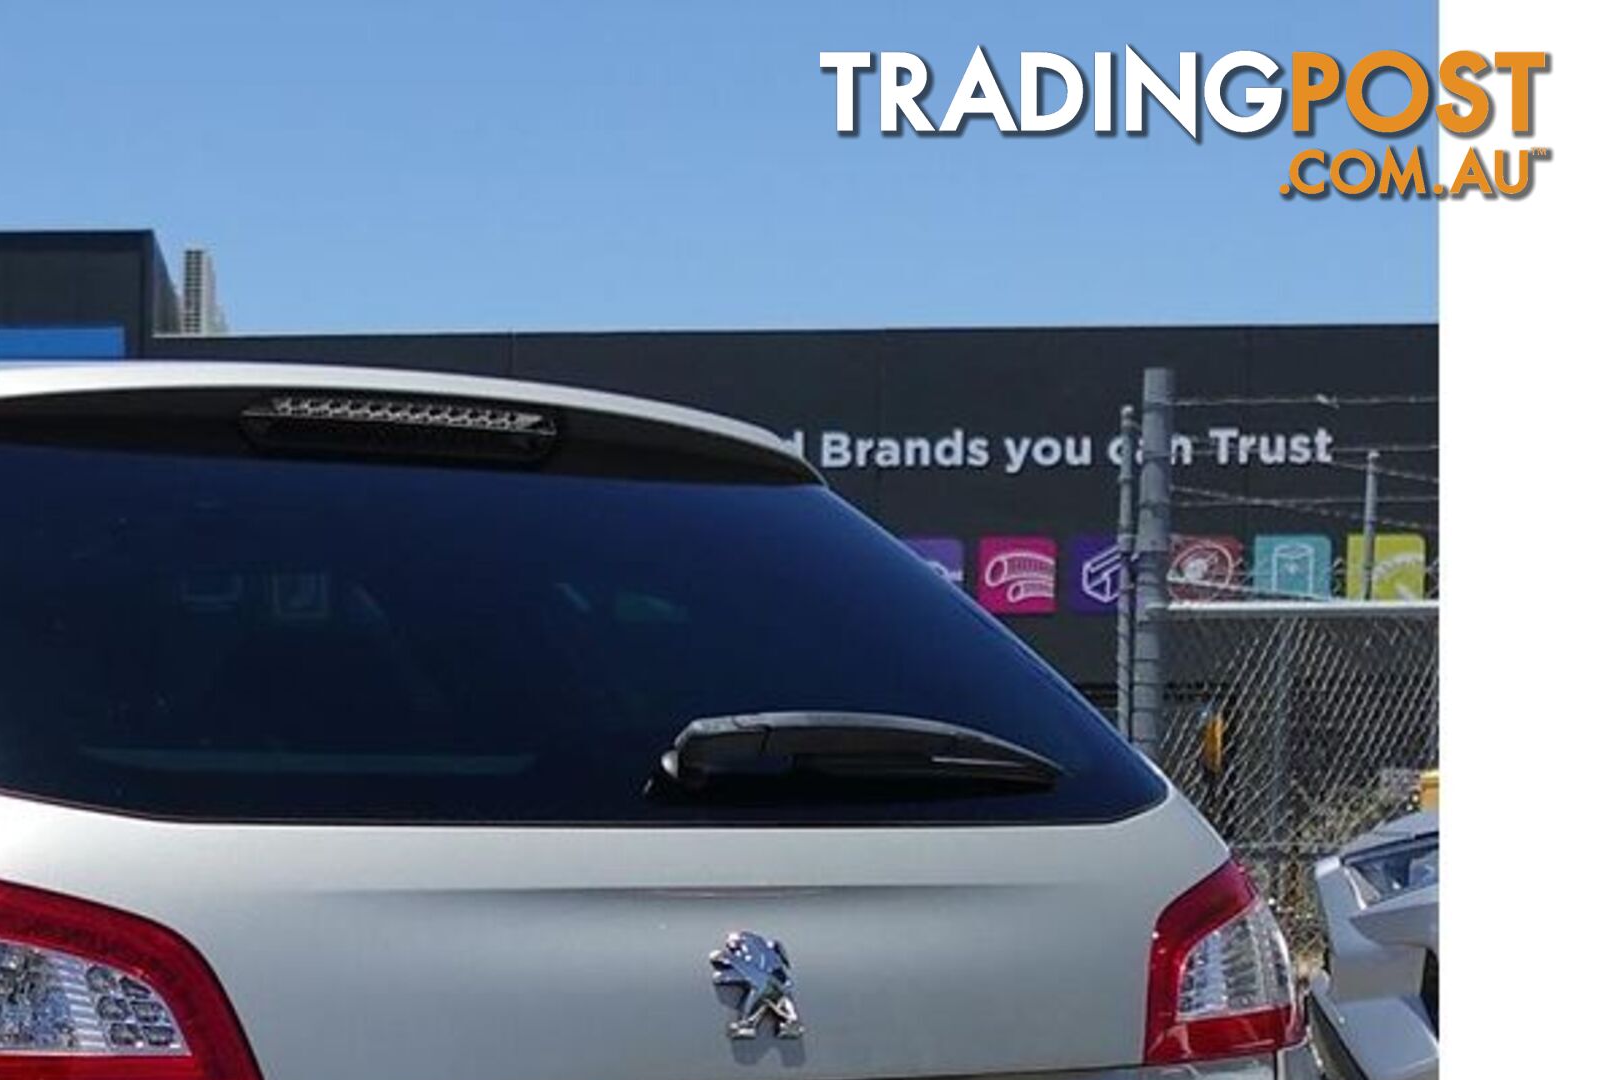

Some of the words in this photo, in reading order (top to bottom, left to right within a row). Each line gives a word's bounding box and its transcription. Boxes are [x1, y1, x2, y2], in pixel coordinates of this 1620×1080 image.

[821, 429, 990, 468] Brands
[1004, 436, 1093, 473] you
[1208, 427, 1333, 466] Trust
